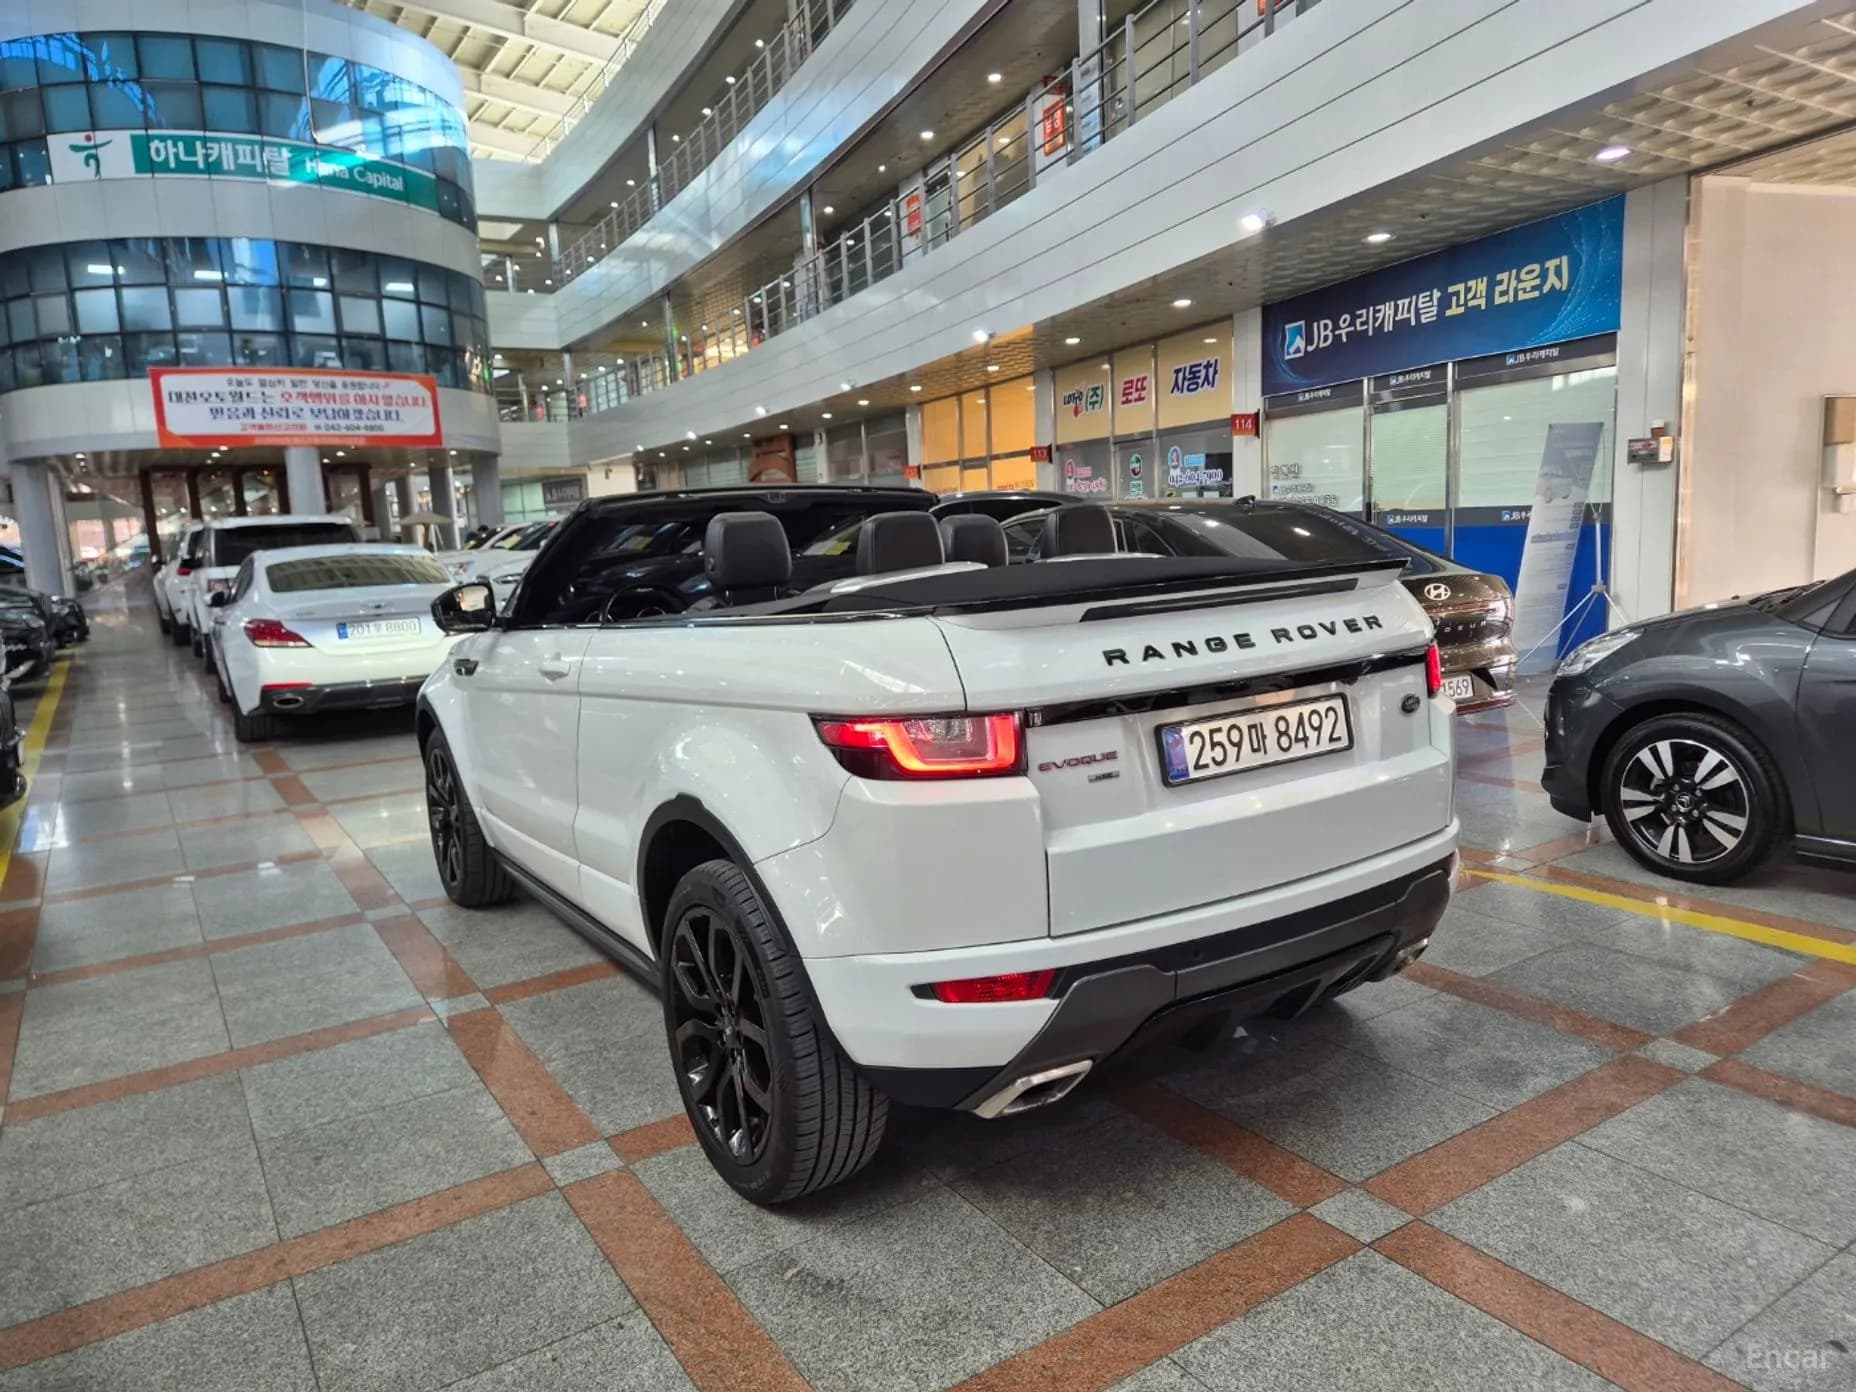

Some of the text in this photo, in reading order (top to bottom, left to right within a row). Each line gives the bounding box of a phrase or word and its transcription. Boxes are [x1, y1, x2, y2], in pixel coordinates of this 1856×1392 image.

[147, 139, 293, 178] 하나캐피탈
[353, 166, 404, 192] Capital
[1306, 255, 1570, 353] JB우리캐피탈 고객 라운지
[1120, 375, 1148, 406] 로또
[1170, 358, 1219, 395] 자동차
[168, 390, 275, 405] 대전오토월드는
[1085, 384, 1104, 411] (주)
[209, 406, 256, 419] 믿음과
[260, 406, 304, 420] 신뢰로
[1234, 417, 1253, 430] 114
[1102, 614, 1384, 666] RANGE ROVER
[1188, 705, 1342, 771] 259마 8492
[1038, 750, 1118, 772] EVOQUE
